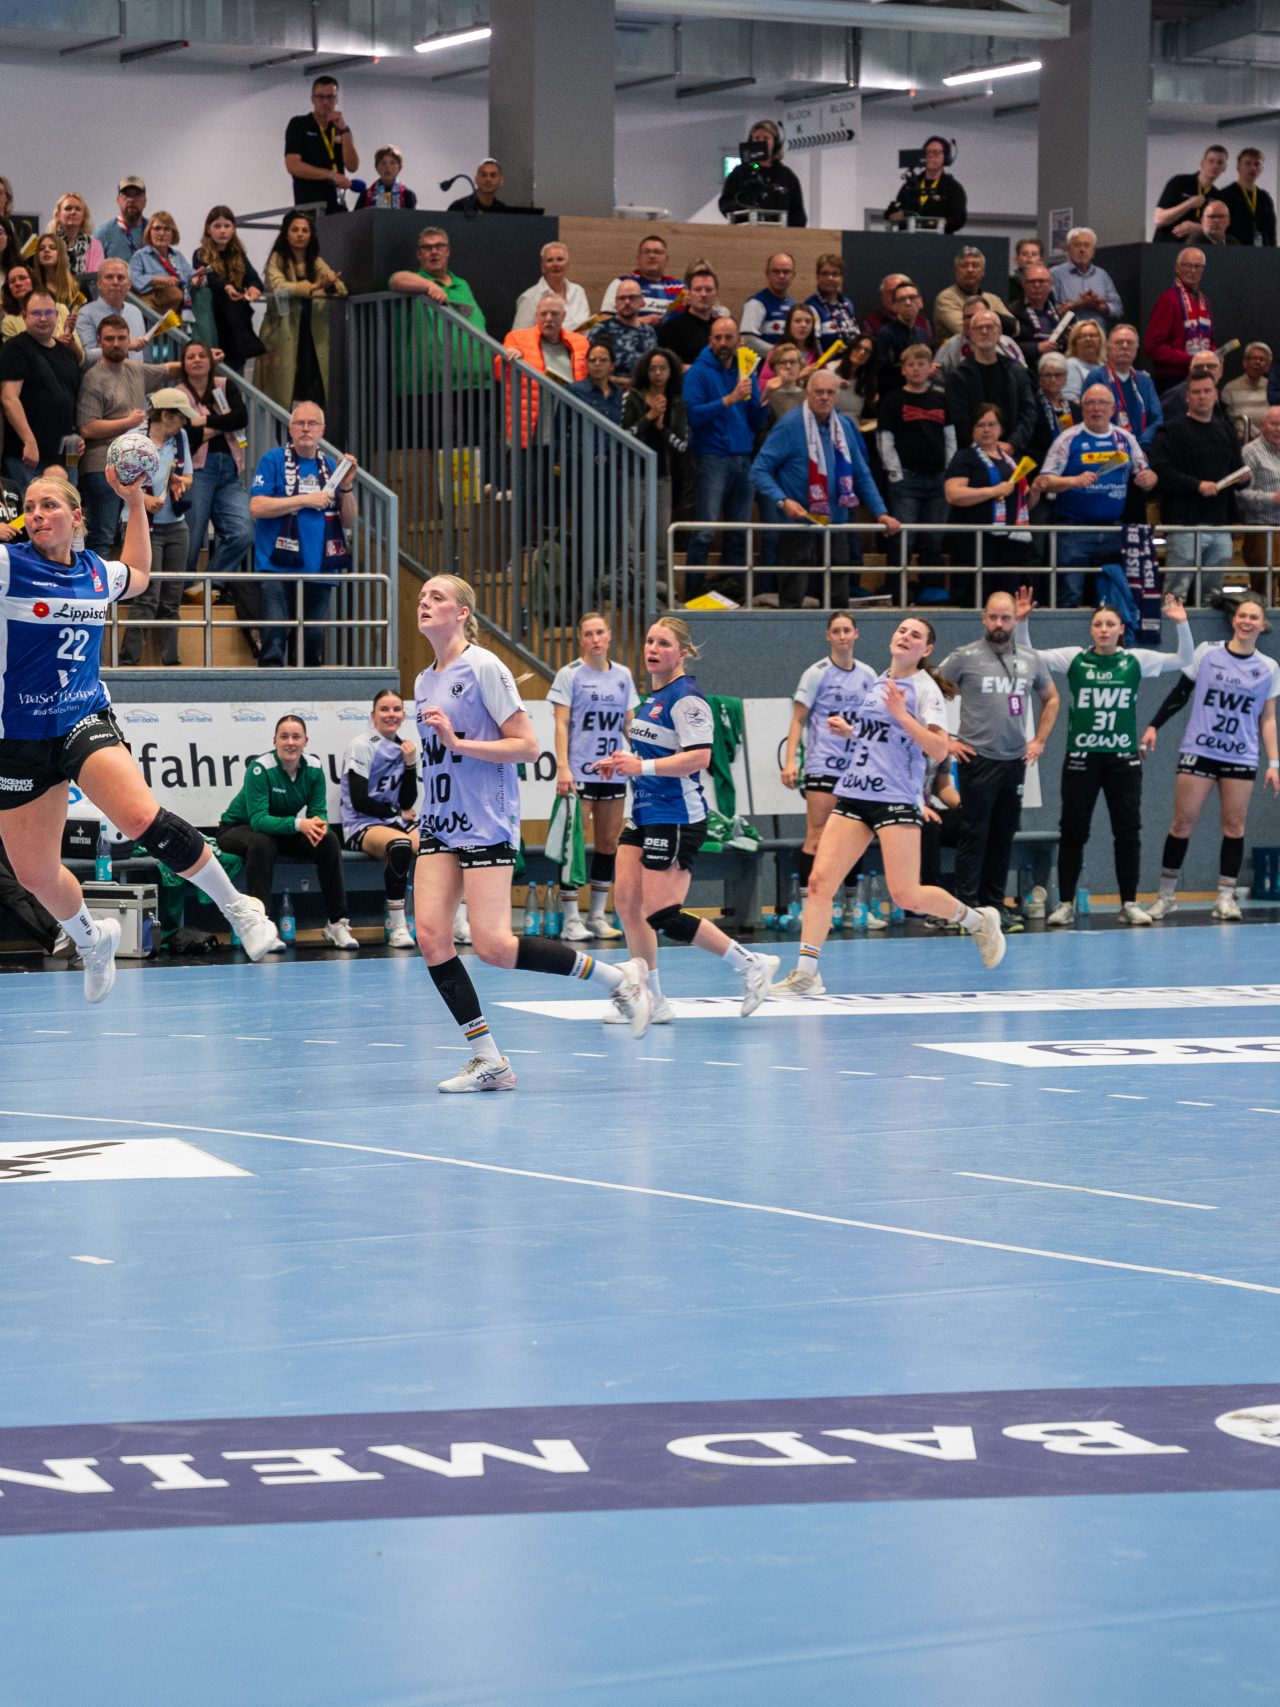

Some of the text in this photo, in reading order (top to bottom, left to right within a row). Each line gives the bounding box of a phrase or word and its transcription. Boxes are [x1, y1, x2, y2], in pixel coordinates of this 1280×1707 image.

[56, 627, 90, 662] 22
[981, 676, 1028, 696] EWE
[1077, 687, 1132, 709] EWE
[1203, 687, 1256, 714] EWE
[1092, 711, 1117, 731] 31
[1211, 714, 1240, 735] 20
[1075, 733, 1132, 748] cewe
[1195, 734, 1247, 755] cewe
[430, 772, 451, 805] 10
[666, 1419, 1189, 1467] BAD
